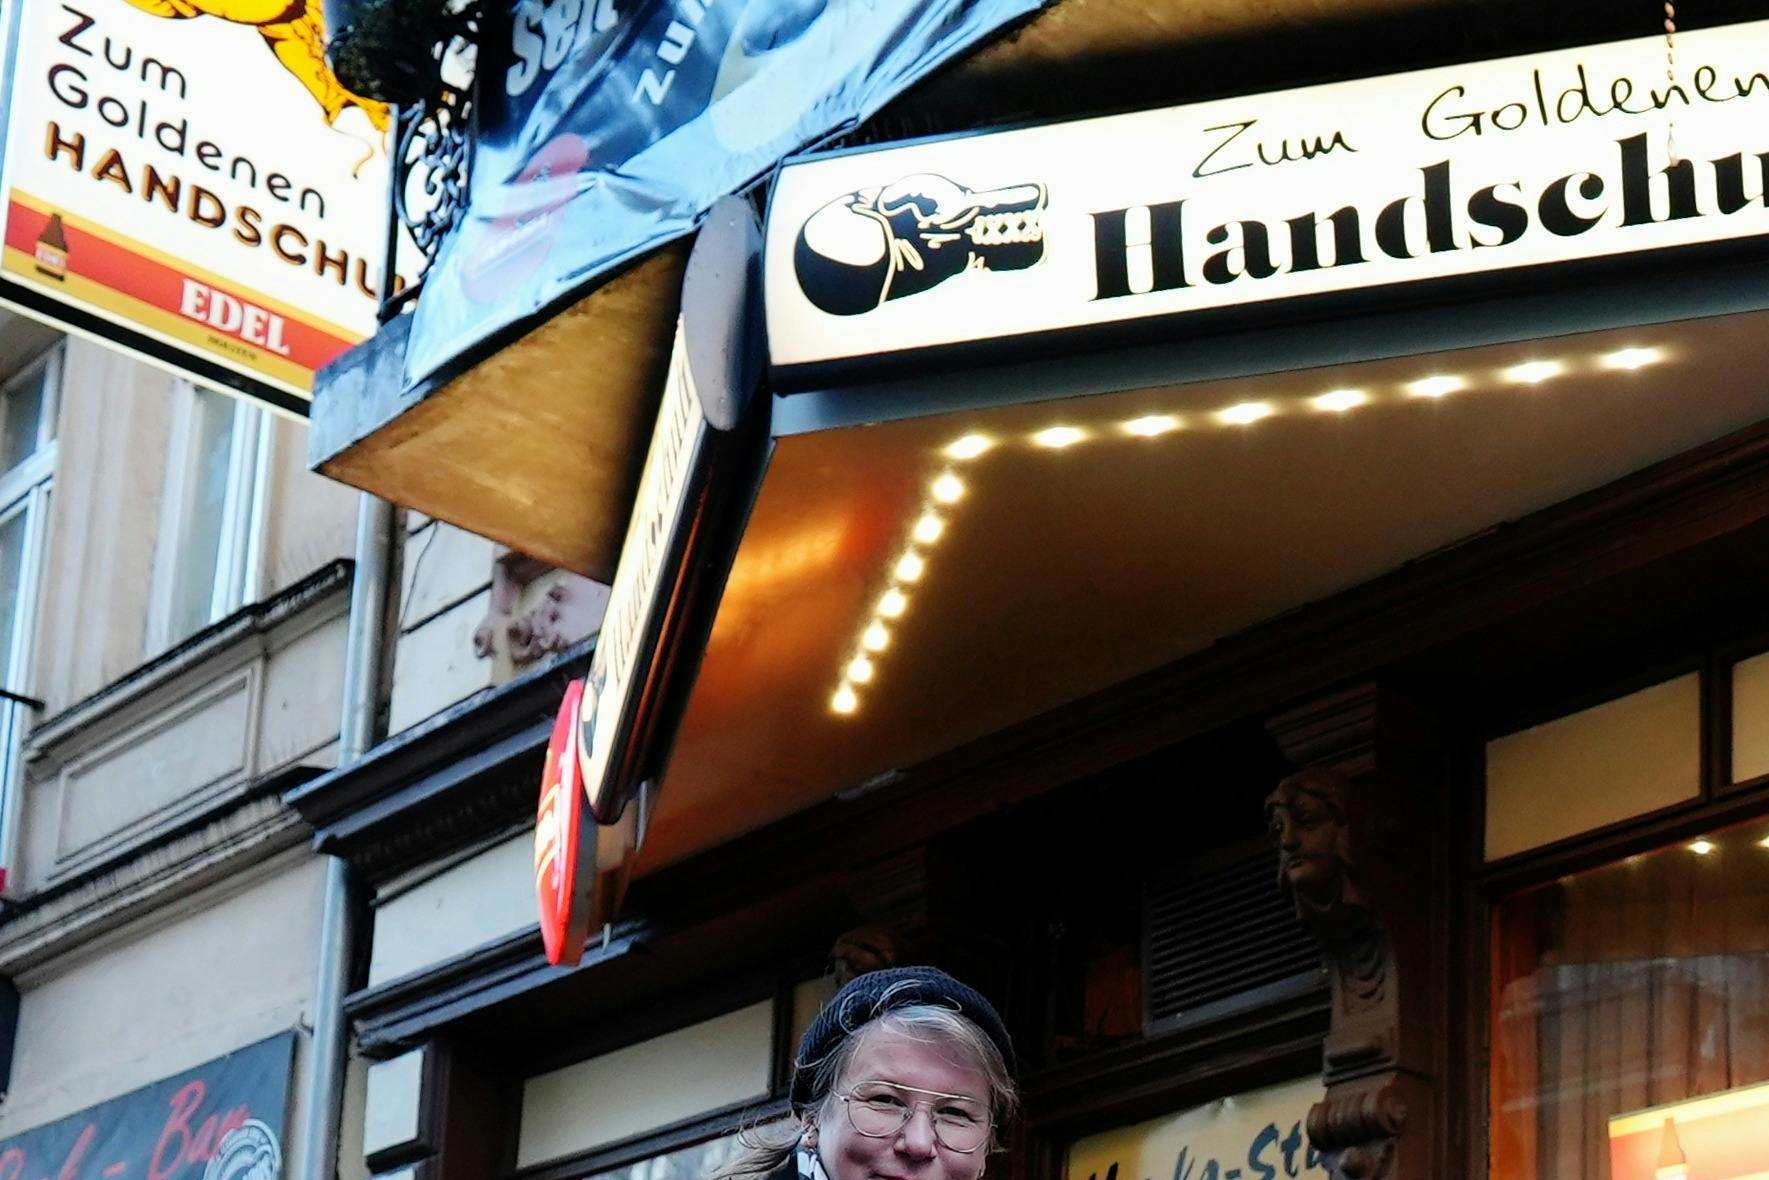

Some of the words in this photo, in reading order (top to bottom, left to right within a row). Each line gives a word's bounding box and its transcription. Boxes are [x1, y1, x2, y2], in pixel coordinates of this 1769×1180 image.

[57, 3, 188, 100] Zum
[47, 62, 328, 219] Goldenen
[1192, 119, 1360, 179] Zum
[179, 278, 291, 356] EDEL
